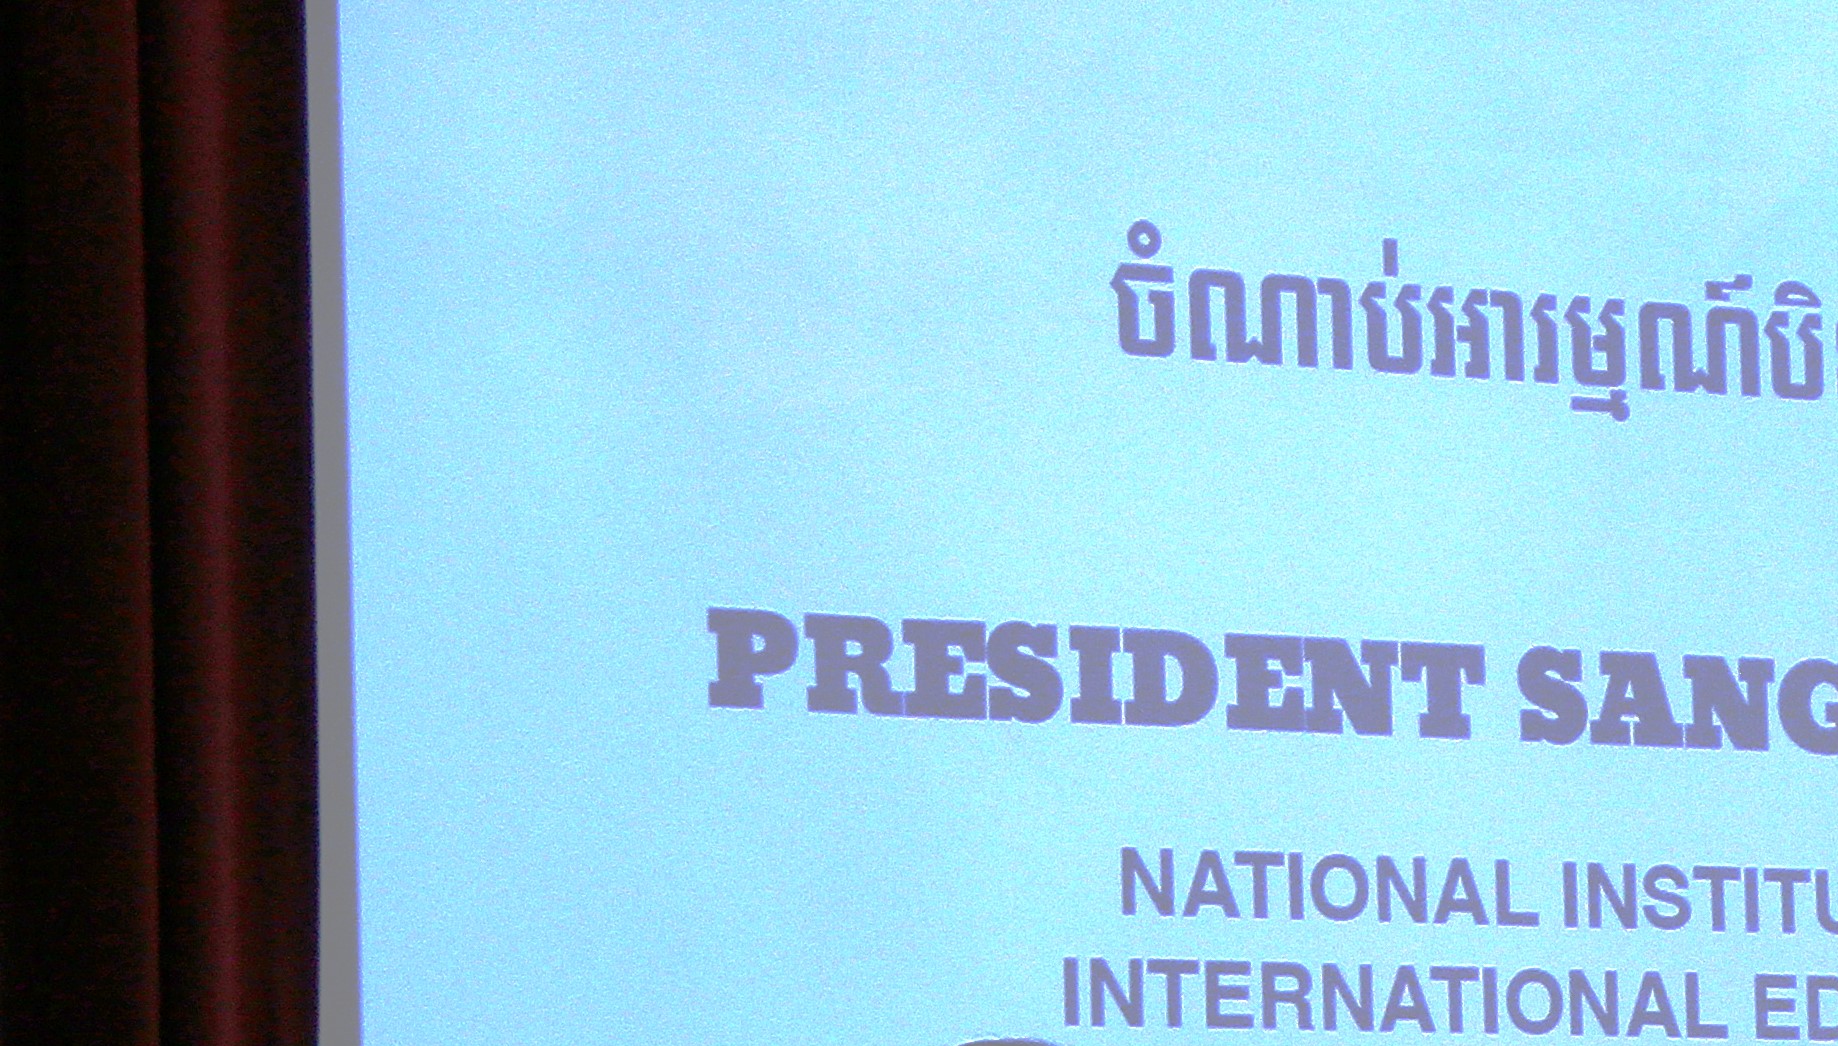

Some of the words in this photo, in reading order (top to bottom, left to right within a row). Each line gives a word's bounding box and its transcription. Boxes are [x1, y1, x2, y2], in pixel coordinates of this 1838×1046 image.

[706, 606, 1486, 740] PRESIDENT
[1120, 846, 1540, 927] NATIONAL
[1063, 957, 1729, 1039] INTERNATIONAL
